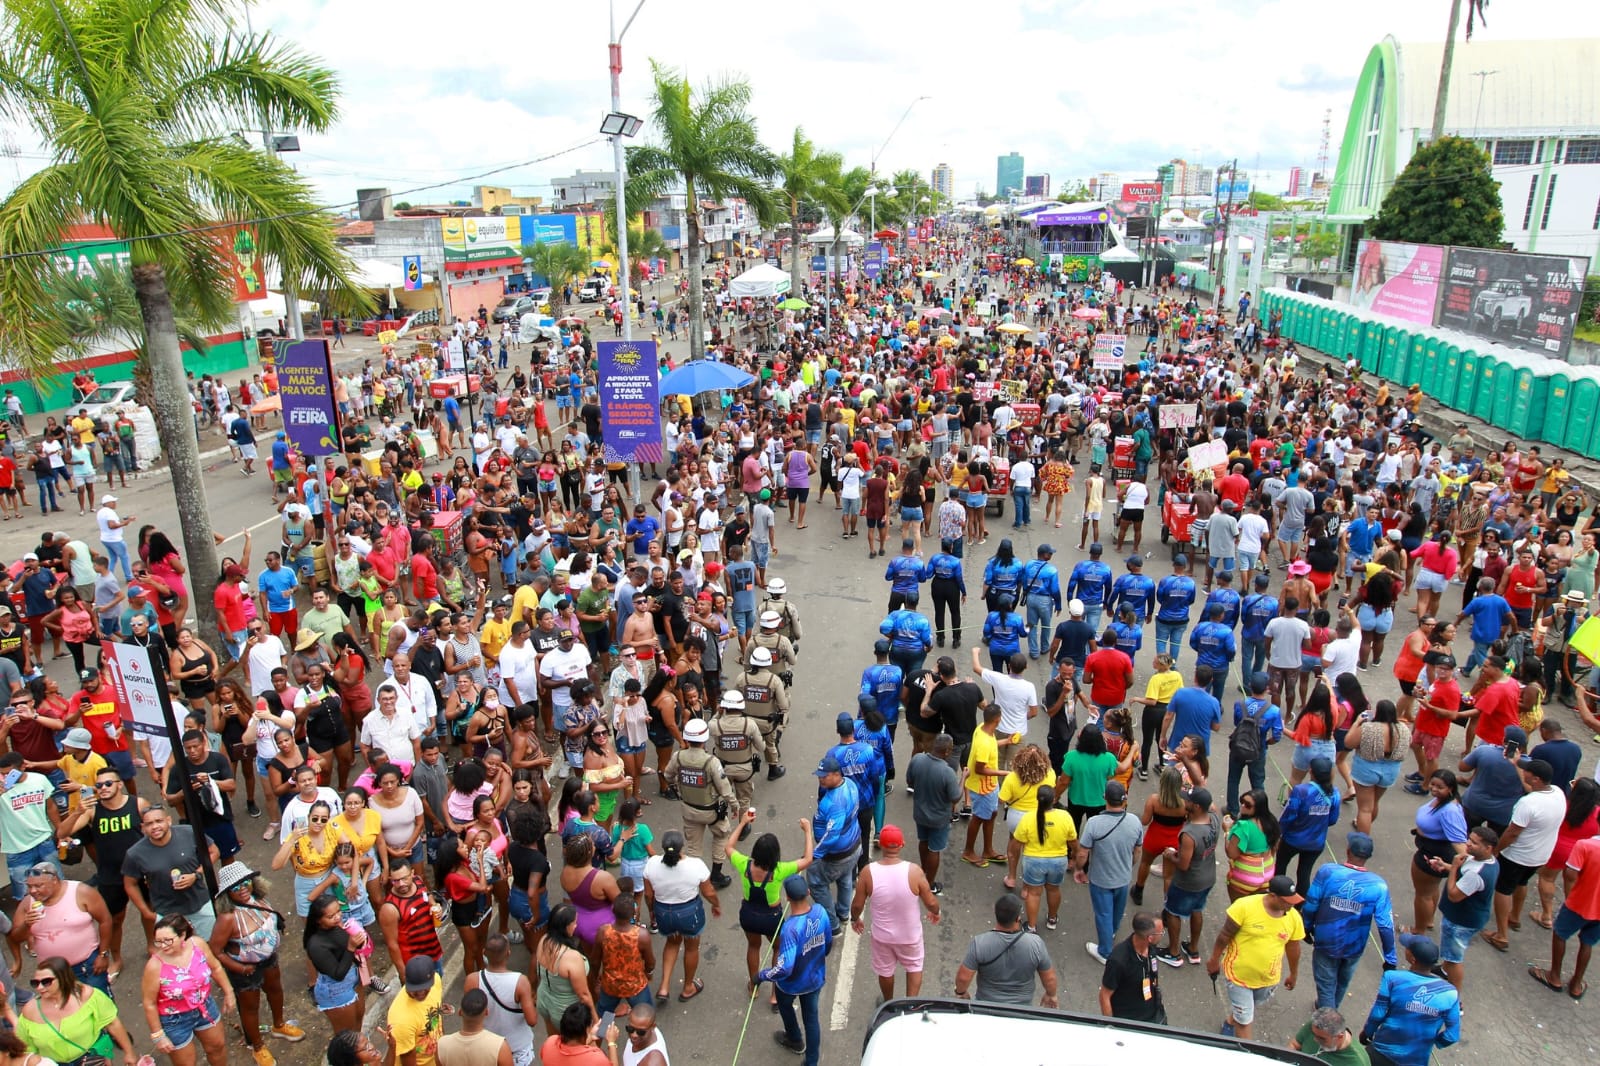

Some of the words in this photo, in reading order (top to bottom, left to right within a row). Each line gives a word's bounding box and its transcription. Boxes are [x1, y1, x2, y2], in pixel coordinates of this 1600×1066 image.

[1546, 271, 1573, 289] TAXA
[1543, 288, 1572, 305] ZERO
[285, 367, 309, 375] GENTE
[289, 375, 315, 385] MAIS
[282, 386, 300, 395] PRA
[301, 384, 326, 395] VOCÊ
[290, 410, 328, 424] FEIRA
[124, 674, 154, 685] HOSPITAL
